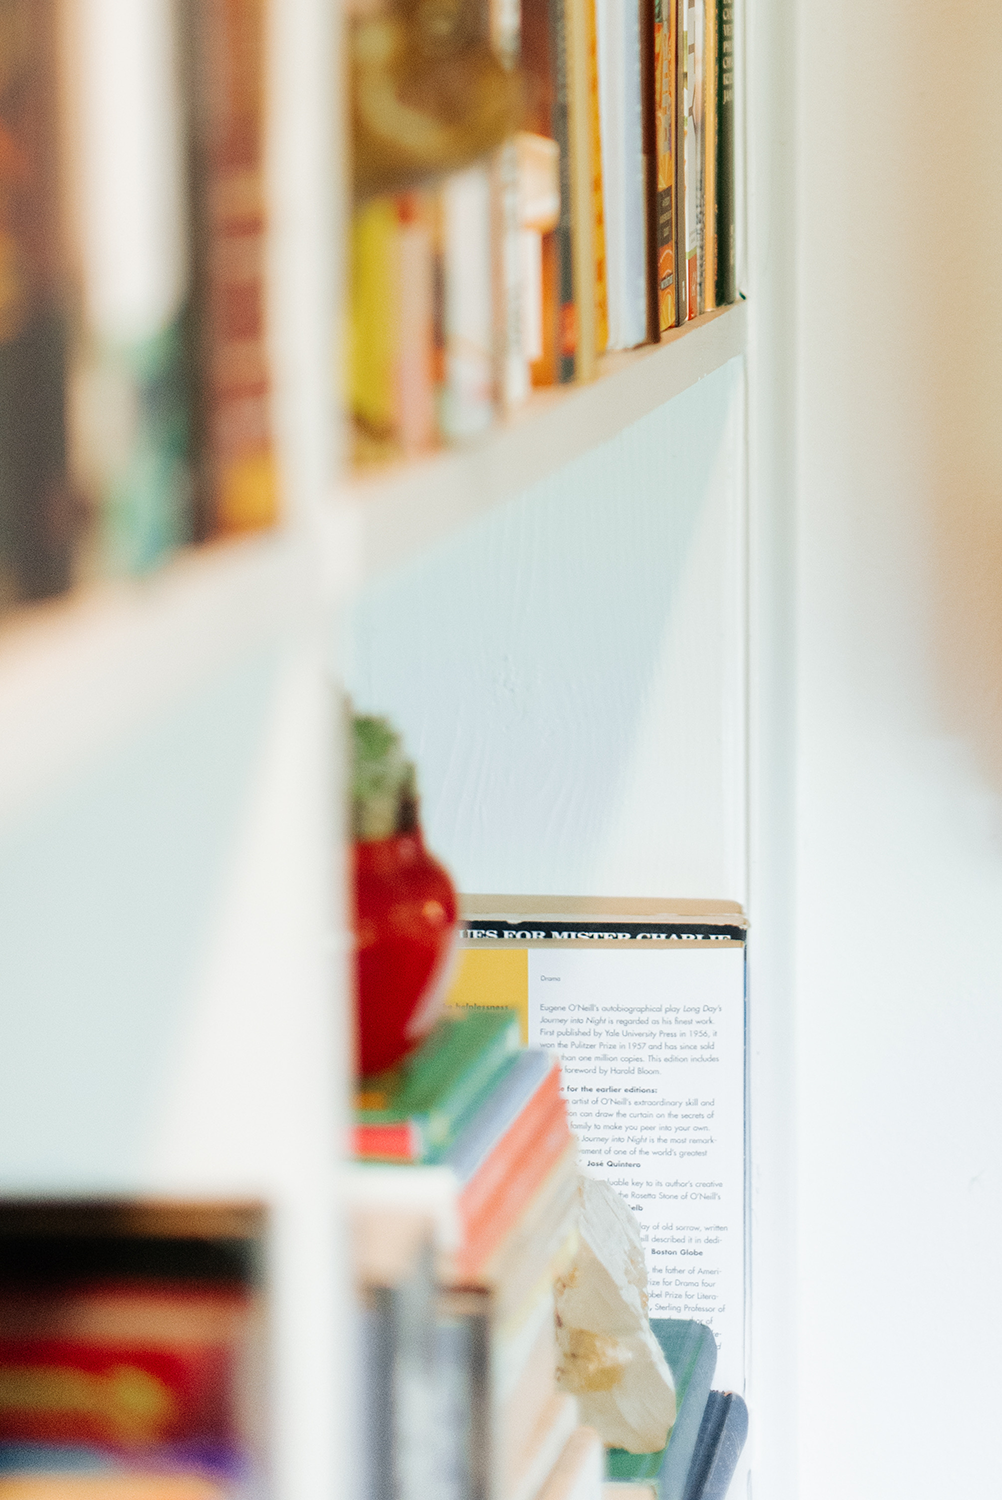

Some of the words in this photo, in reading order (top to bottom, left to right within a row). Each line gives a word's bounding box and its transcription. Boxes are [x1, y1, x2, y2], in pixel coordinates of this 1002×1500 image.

[502, 930, 546, 939] FOR
[540, 1003, 566, 1013] Eugene
[601, 1004, 662, 1014] autobiographical
[665, 1004, 680, 1014] play
[683, 1004, 700, 1014] Long
[540, 1016, 568, 1026] Journey
[570, 1016, 584, 1024] into
[586, 1016, 606, 1026] Night
[616, 1016, 649, 1026] regarded
[662, 1017, 672, 1025] his
[674, 1017, 693, 1025] finest
[540, 1028, 554, 1036] First
[557, 1028, 591, 1038] published
[605, 1028, 620, 1037] Yale
[622, 1029, 657, 1039] University
[659, 1029, 677, 1037] Press
[557, 1040, 568, 1049] the
[571, 1040, 596, 1049] Pulitzer
[599, 1041, 617, 1049] Prize
[628, 1041, 646, 1049] 1957
[648, 1041, 662, 1049] and
[664, 1041, 677, 1050] has
[680, 1041, 697, 1050] since
[700, 1041, 715, 1050] sold
[561, 1053, 576, 1062] than
[594, 1053, 618, 1062] million
[648, 1054, 661, 1062] This
[664, 1054, 688, 1063] edition
[691, 1054, 719, 1063] includes
[565, 1066, 597, 1074] foreword
[610, 1066, 635, 1075] Harold
[567, 1084, 578, 1092] for
[581, 1084, 593, 1092] the
[596, 1084, 622, 1093] earlier
[572, 1097, 589, 1105] artist
[634, 1098, 682, 1108] extraordinary
[685, 1098, 698, 1107] skill
[700, 1098, 715, 1107] and
[595, 1109, 614, 1118] draw
[616, 1110, 627, 1118] the
[629, 1110, 653, 1118] curtain
[668, 1110, 678, 1119] the
[681, 1111, 704, 1119] secrets
[571, 1122, 592, 1132] family
[603, 1122, 622, 1131] make
[625, 1124, 638, 1132] you
[640, 1124, 656, 1133] peer
[659, 1123, 672, 1131] into
[674, 1125, 690, 1133] your
[582, 1134, 609, 1144] Journey
[611, 1134, 625, 1143] into
[627, 1134, 647, 1144] Night
[657, 1135, 668, 1143] the
[670, 1135, 687, 1143] most
[639, 1148, 649, 1156] the
[679, 1149, 707, 1158] greatest
[606, 1160, 641, 1168] Quintero
[631, 1178, 643, 1188] key
[655, 1179, 663, 1187] its
[695, 1179, 723, 1188] creative
[631, 1191, 656, 1199] Rosetta
[659, 1191, 678, 1200] Stone
[629, 1204, 643, 1212] elb
[638, 1222, 650, 1232] lay
[662, 1222, 673, 1231] old
[704, 1223, 728, 1232] written
[651, 1235, 686, 1243] described
[652, 1265, 663, 1274] the
[665, 1266, 685, 1274] father
[662, 1278, 672, 1287] for
[675, 1279, 699, 1287] Drama
[701, 1279, 715, 1288] four
[647, 1290, 662, 1299] obel
[665, 1291, 682, 1299] Prize
[685, 1291, 695, 1300] for
[655, 1302, 681, 1312] Sterling
[684, 1304, 715, 1312] Professor
[705, 1317, 713, 1325] of
